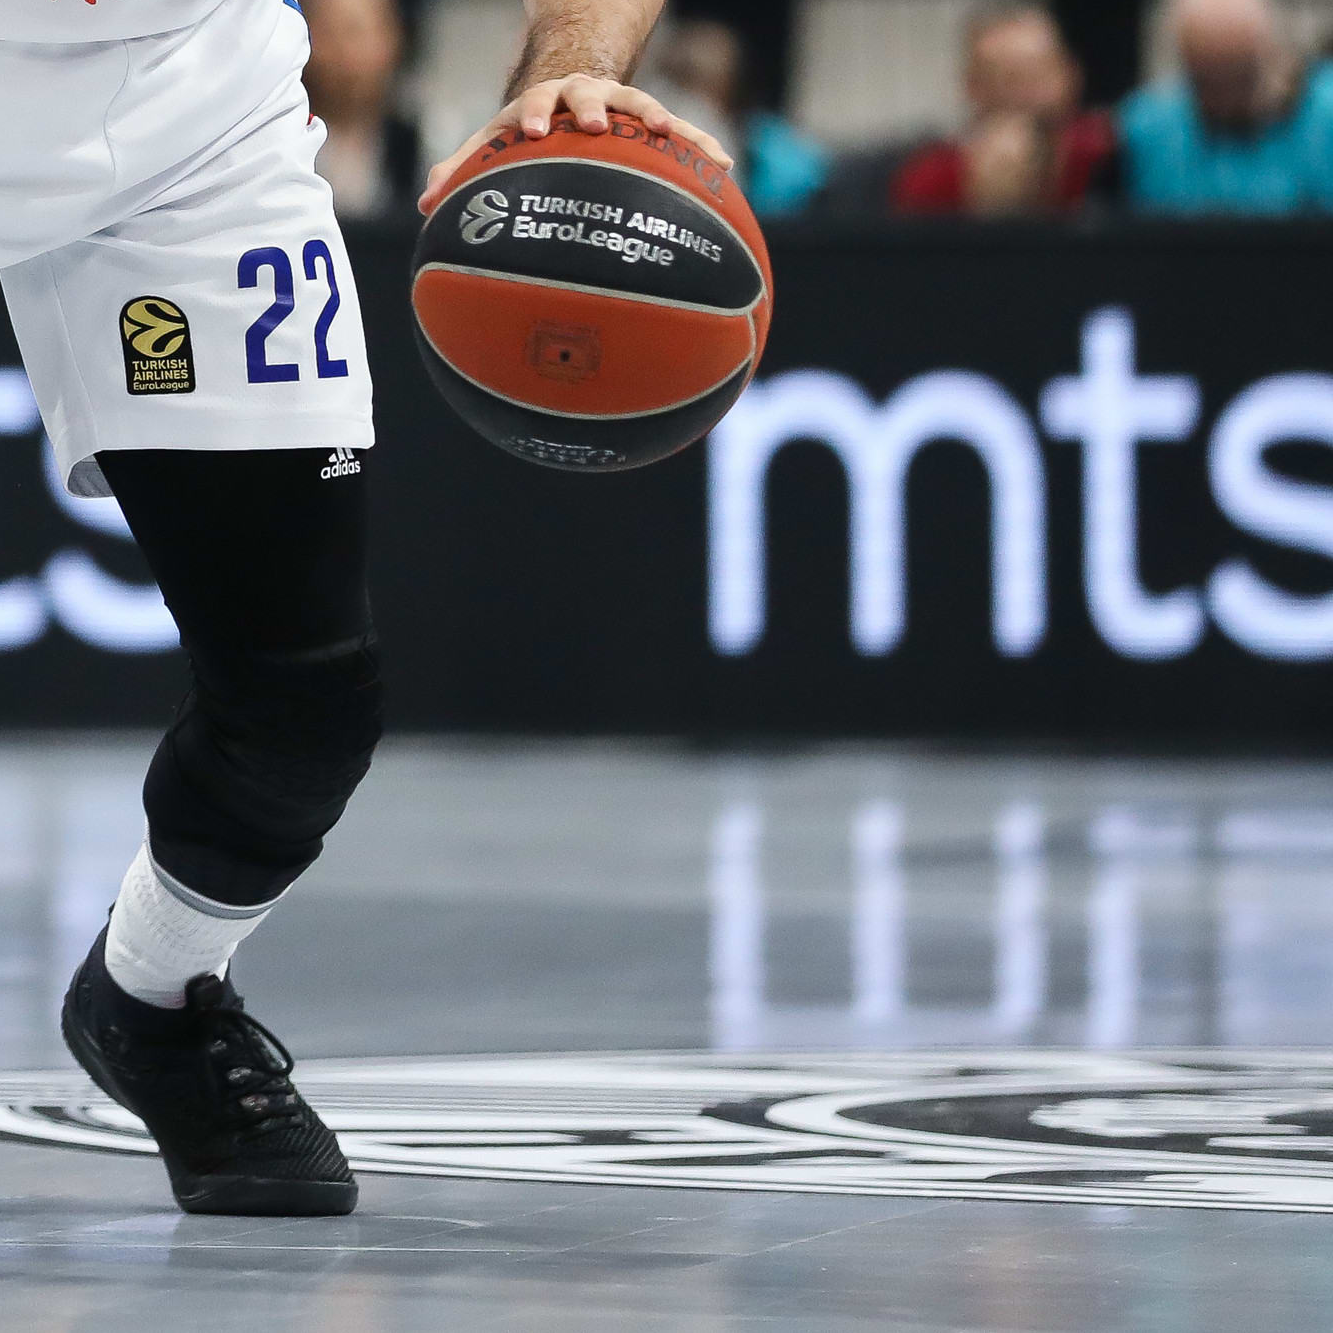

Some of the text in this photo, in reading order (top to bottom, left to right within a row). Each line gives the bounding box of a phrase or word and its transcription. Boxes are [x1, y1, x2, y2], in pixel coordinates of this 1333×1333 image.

[519, 194, 723, 264] TURKISH AIRLINES
[511, 215, 676, 267] EuroLeague
[236, 238, 351, 385] 22
[132, 358, 188, 371] TURKISH
[133, 369, 189, 381] AIRLINES
[133, 381, 190, 391] EuroLeague
[320, 458, 361, 480] adidas
